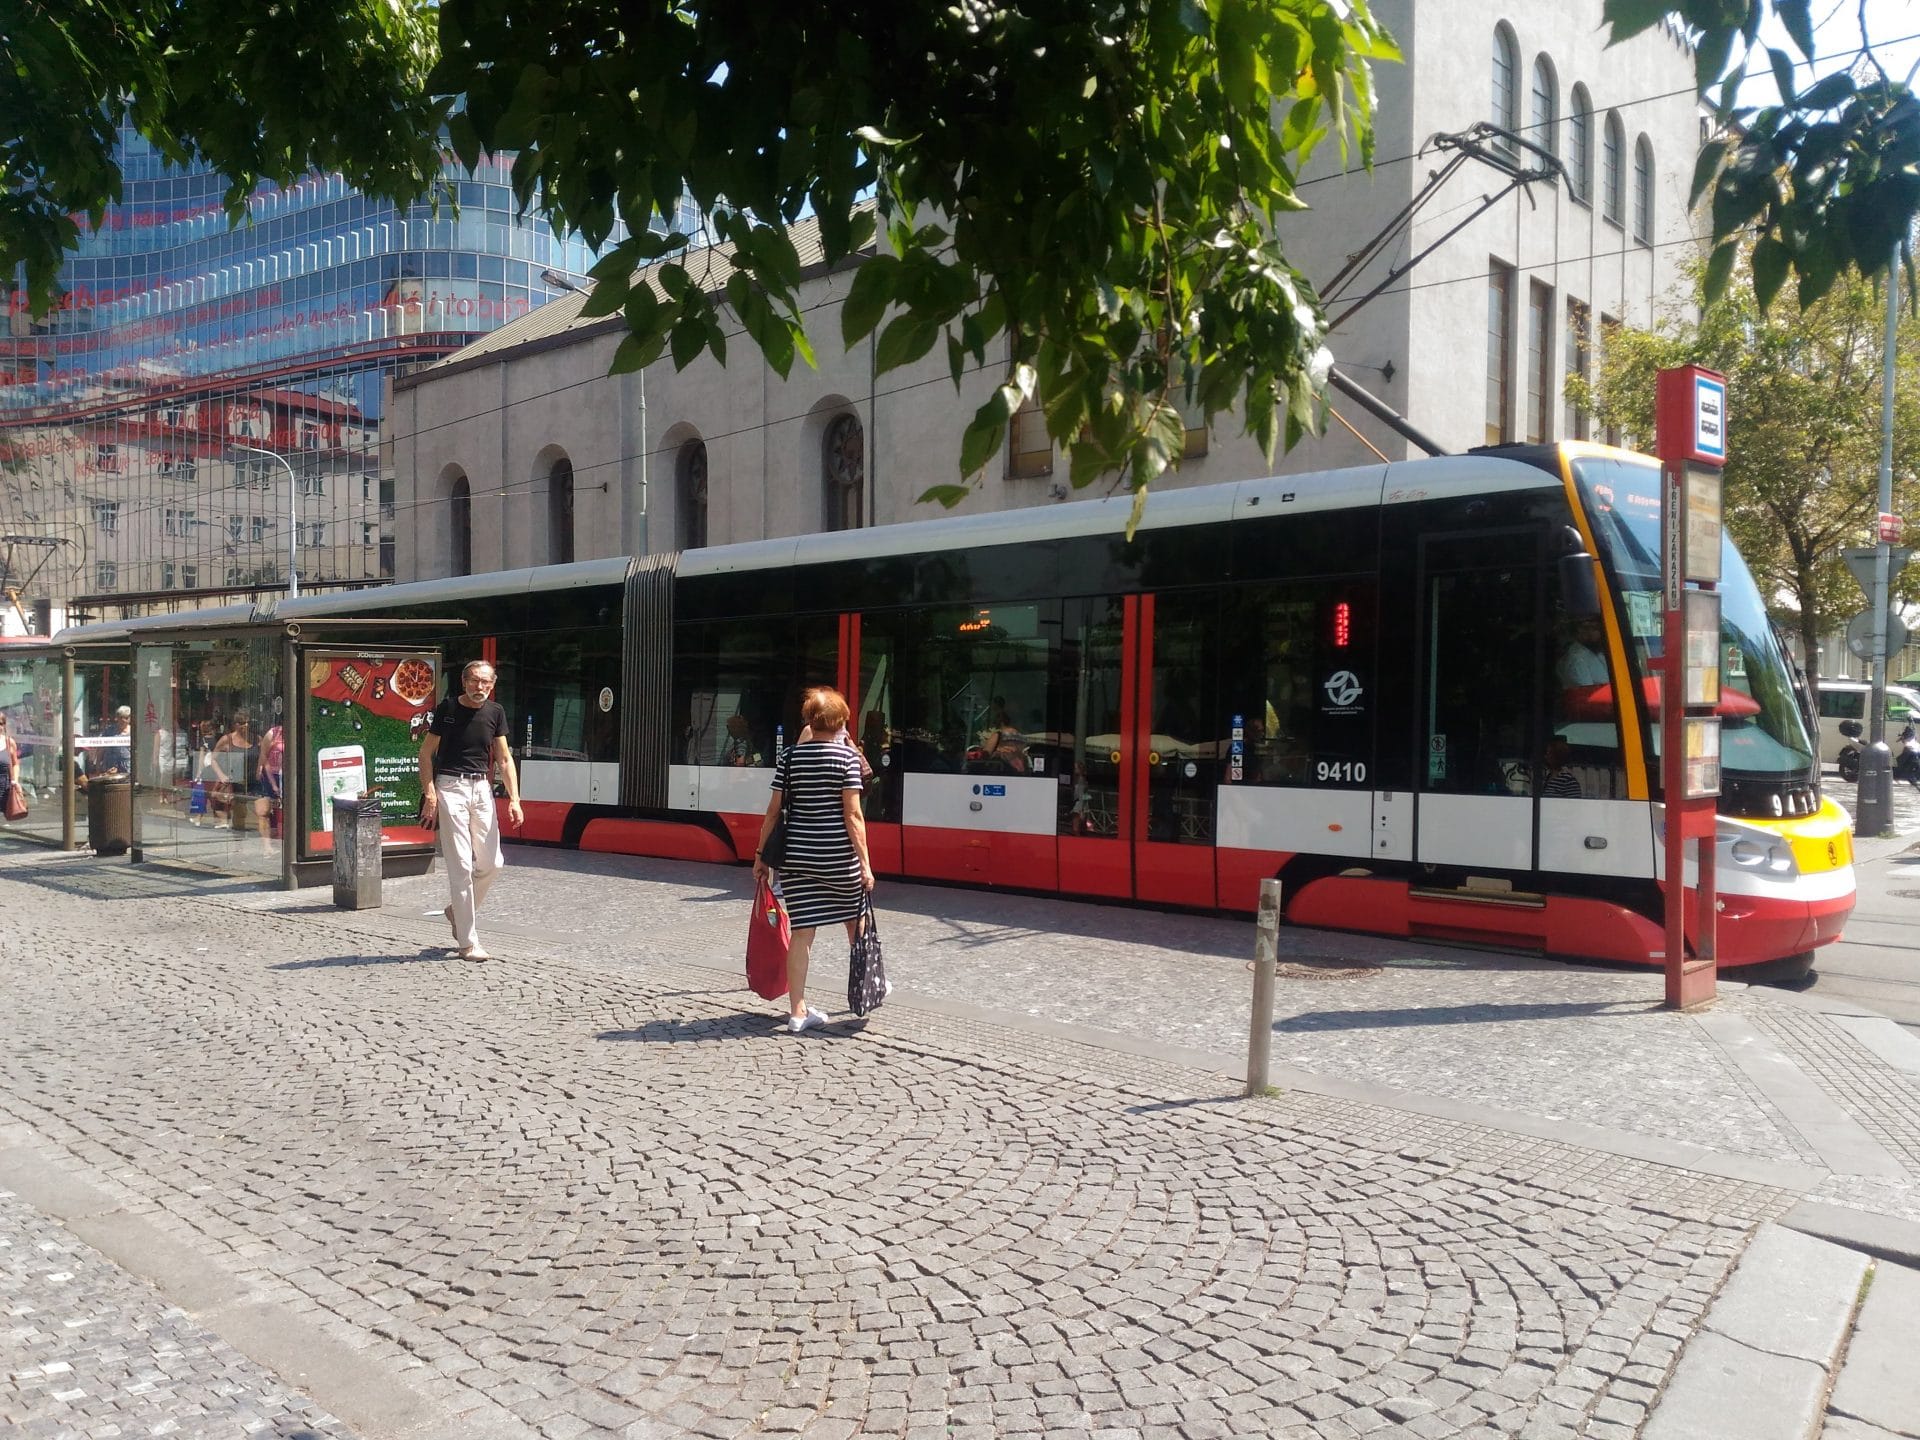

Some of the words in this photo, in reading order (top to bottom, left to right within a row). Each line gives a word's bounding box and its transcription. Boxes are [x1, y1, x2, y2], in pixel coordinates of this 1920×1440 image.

[375, 757, 410, 765] Piknikujte
[390, 765, 410, 774] právě
[1317, 762, 1366, 782] 9410
[375, 790, 397, 798] Picnic
[381, 800, 412, 808] ywhere.
